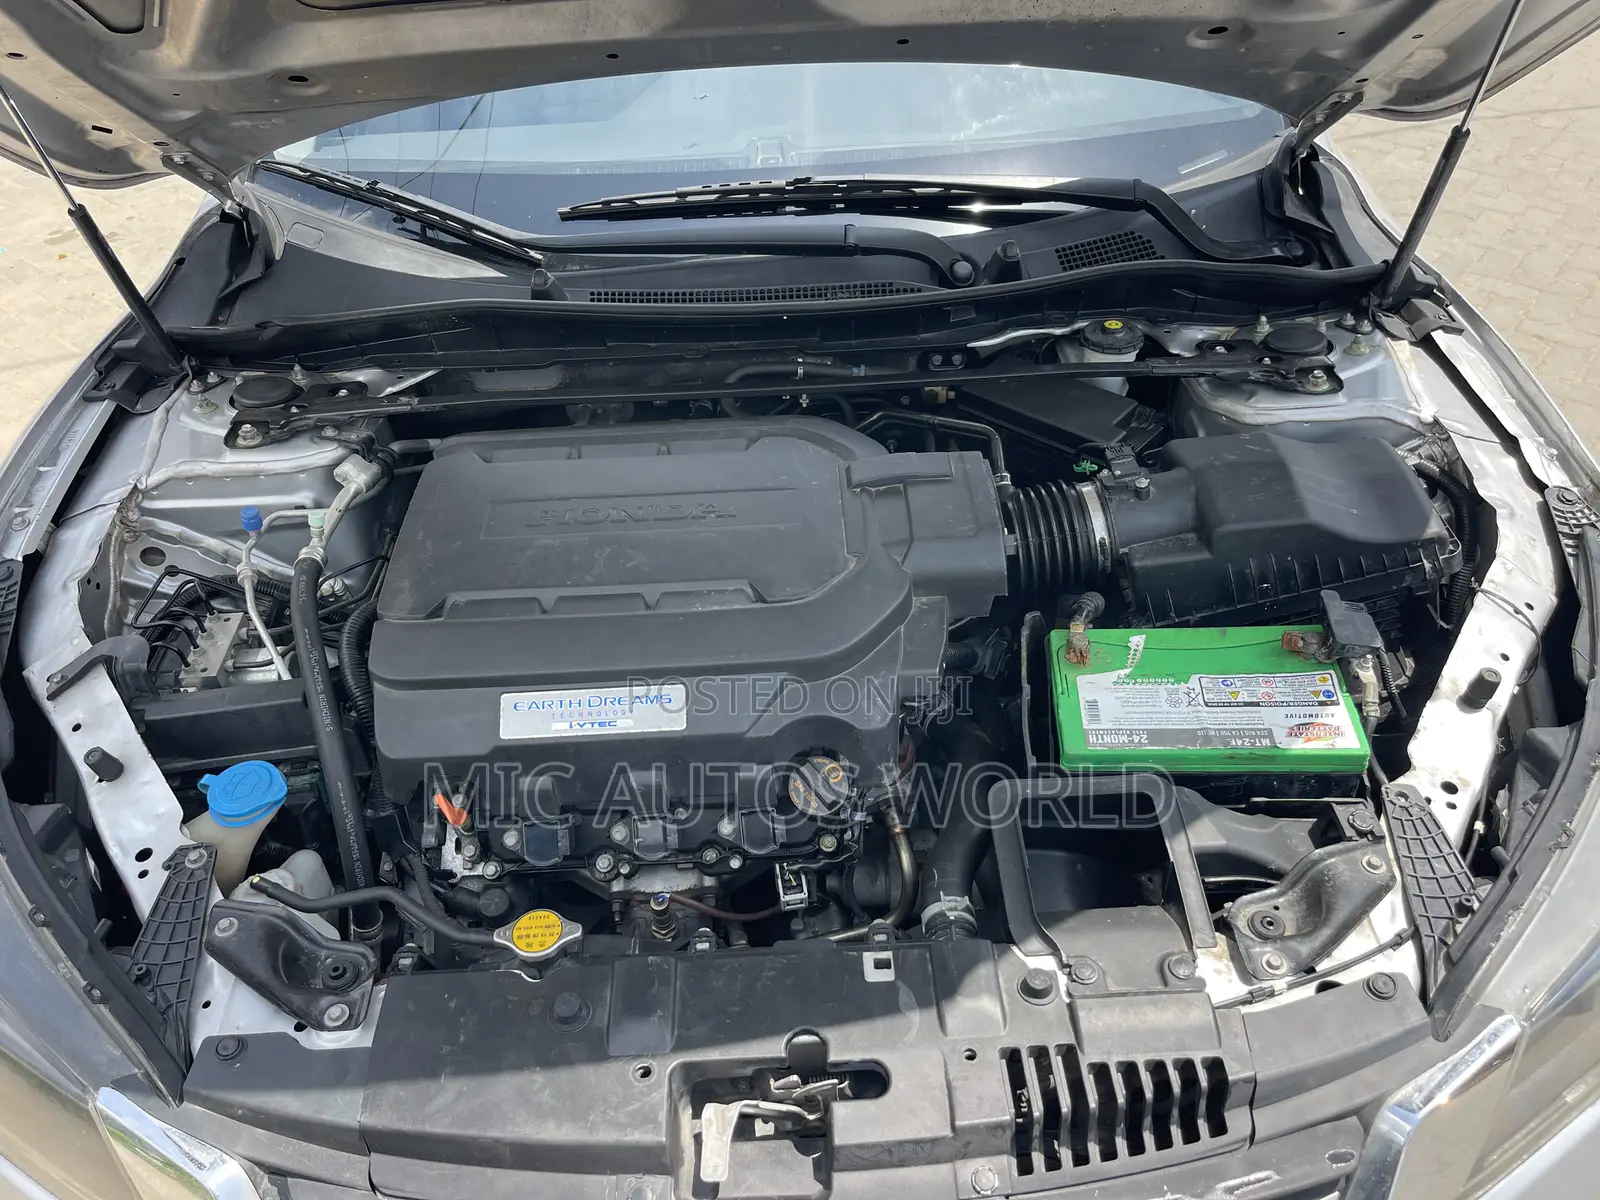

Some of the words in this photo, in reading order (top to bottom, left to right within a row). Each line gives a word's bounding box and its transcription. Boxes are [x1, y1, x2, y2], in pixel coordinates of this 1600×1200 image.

[525, 502, 737, 528] HONDA
[513, 700, 582, 712] EARTH
[587, 693, 673, 708] DREAMS
[1088, 734, 1149, 744] 24-MONTH
